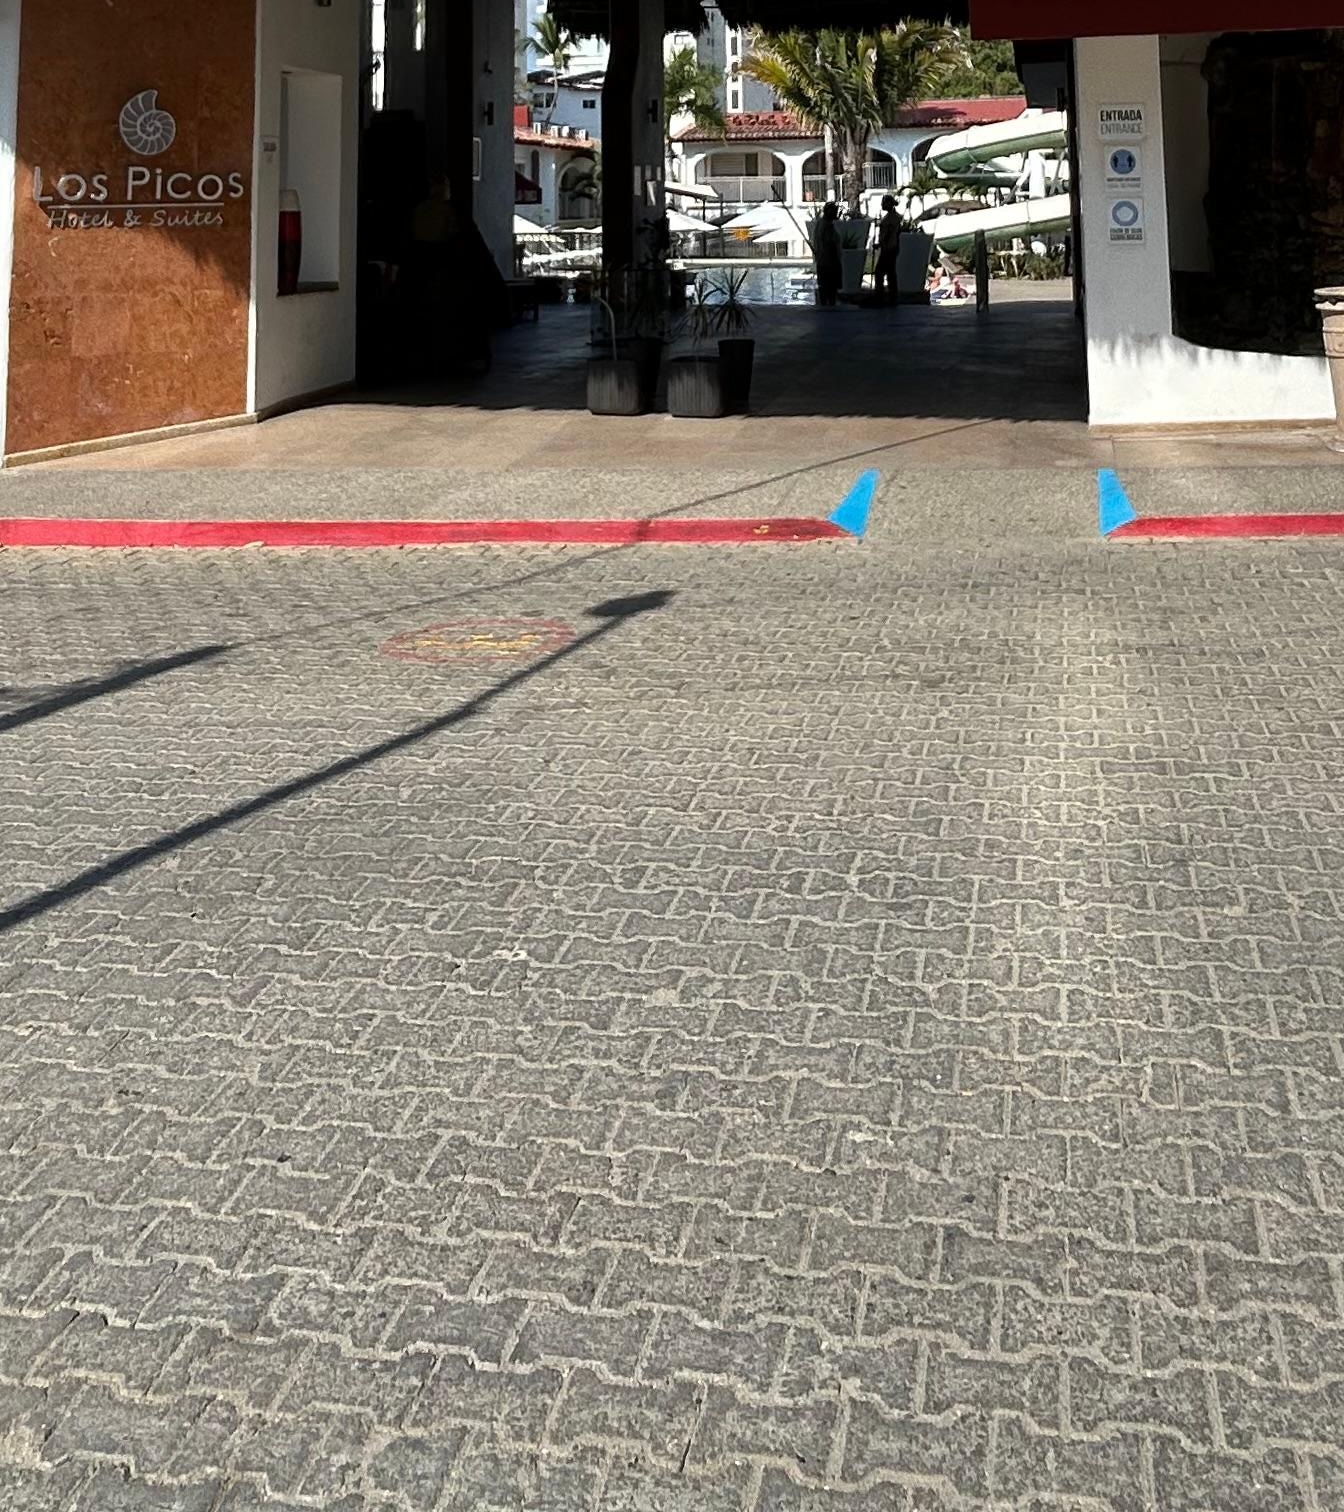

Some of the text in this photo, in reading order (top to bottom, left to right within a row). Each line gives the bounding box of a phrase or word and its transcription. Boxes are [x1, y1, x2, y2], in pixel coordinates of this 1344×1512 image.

[1100, 109, 1143, 122] ENTRADA
[1100, 123, 1143, 135] ENTRANCE
[32, 166, 108, 202] Los
[47, 209, 224, 229] Hotel & Suites
